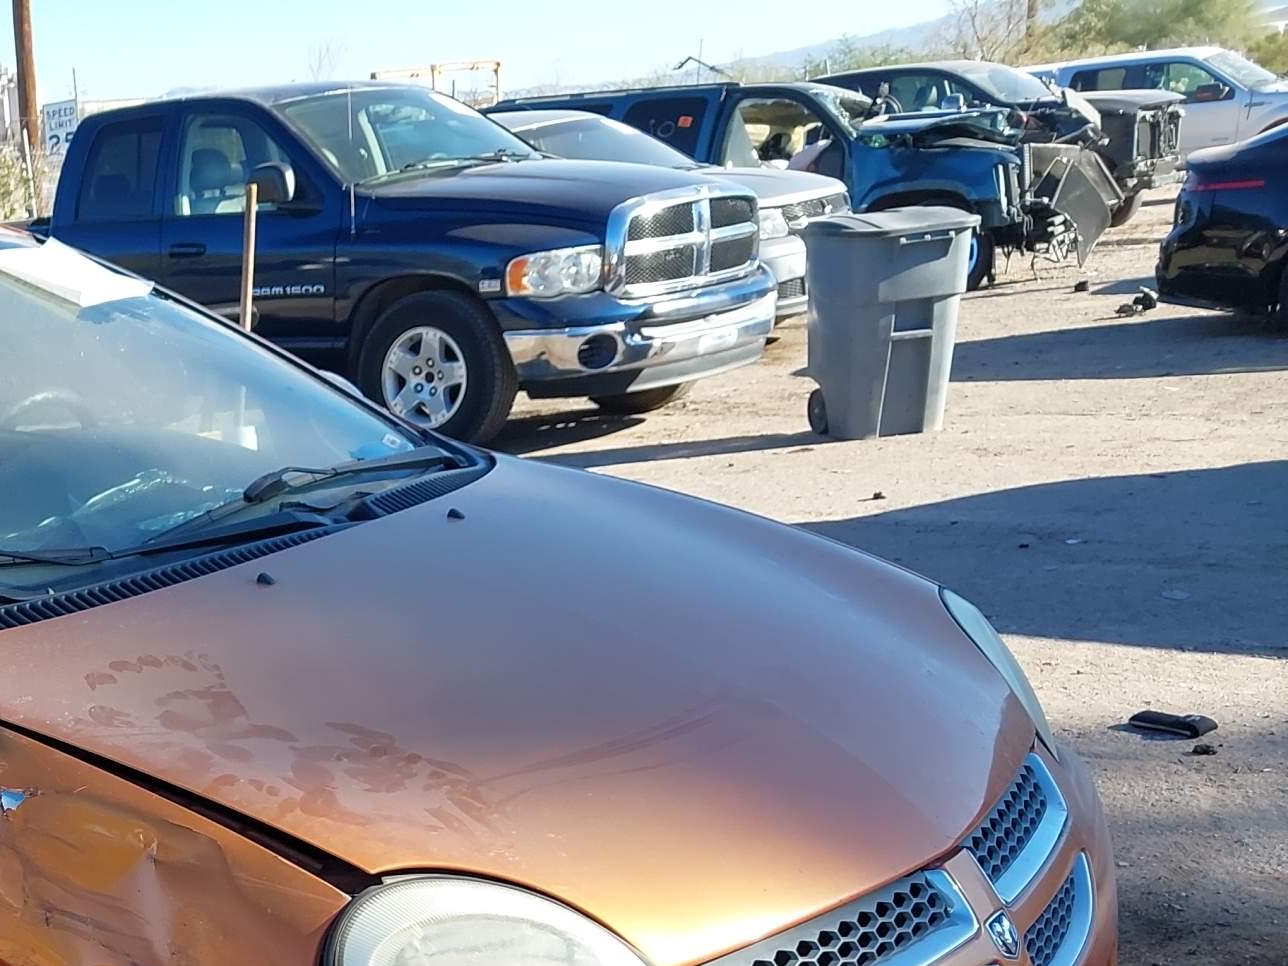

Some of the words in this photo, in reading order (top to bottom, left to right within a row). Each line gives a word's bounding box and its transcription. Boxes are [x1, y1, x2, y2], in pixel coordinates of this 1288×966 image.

[46, 107, 75, 119] SPEED
[49, 119, 73, 131] LIMIT
[285, 284, 325, 295] 1500
